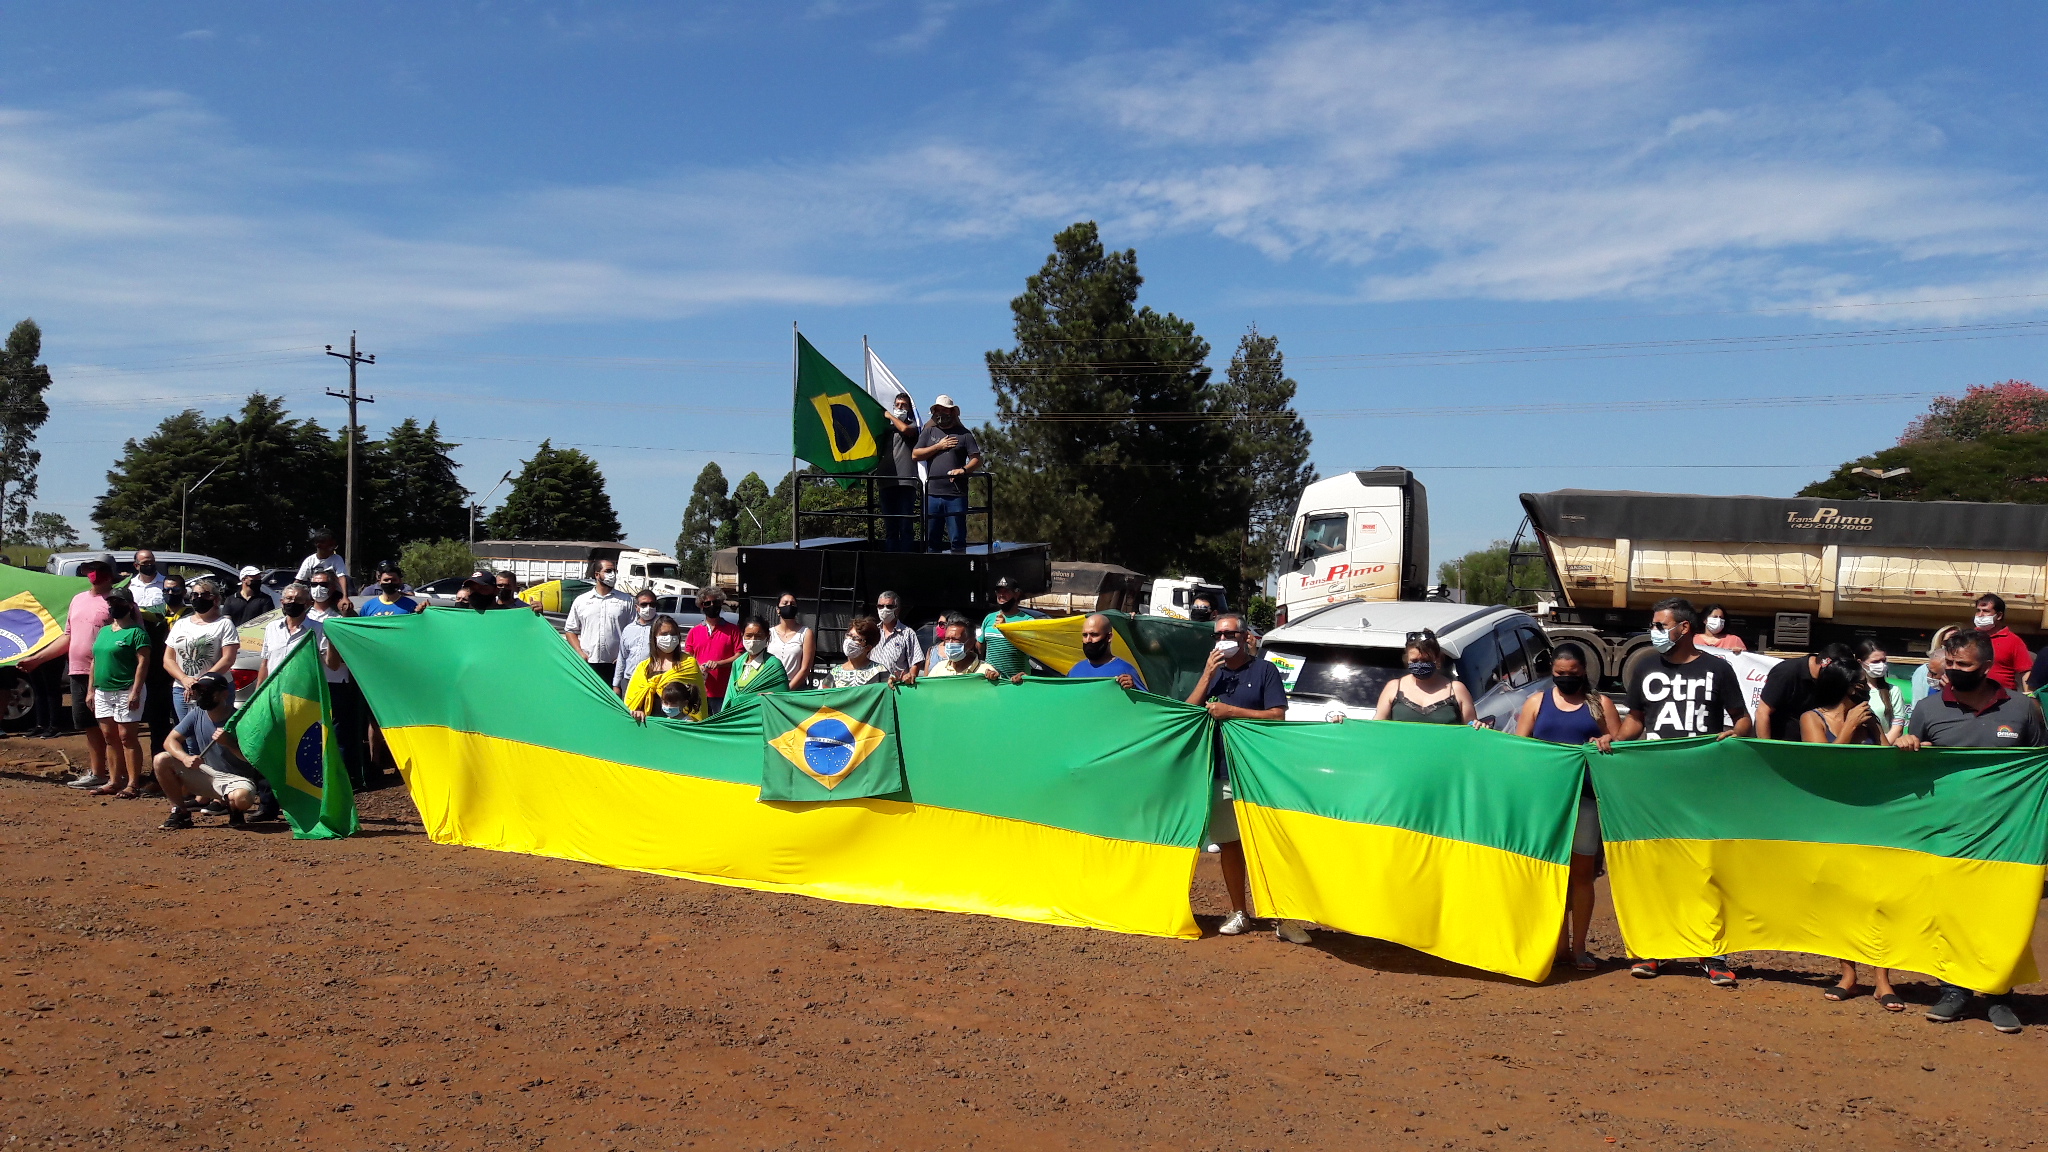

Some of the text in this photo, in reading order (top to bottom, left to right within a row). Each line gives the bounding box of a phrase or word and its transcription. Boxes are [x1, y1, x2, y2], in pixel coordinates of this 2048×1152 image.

[1814, 523, 1873, 531] 2101-7000
[1642, 671, 1714, 702] Ctrl
[1653, 700, 1709, 733] Alt
